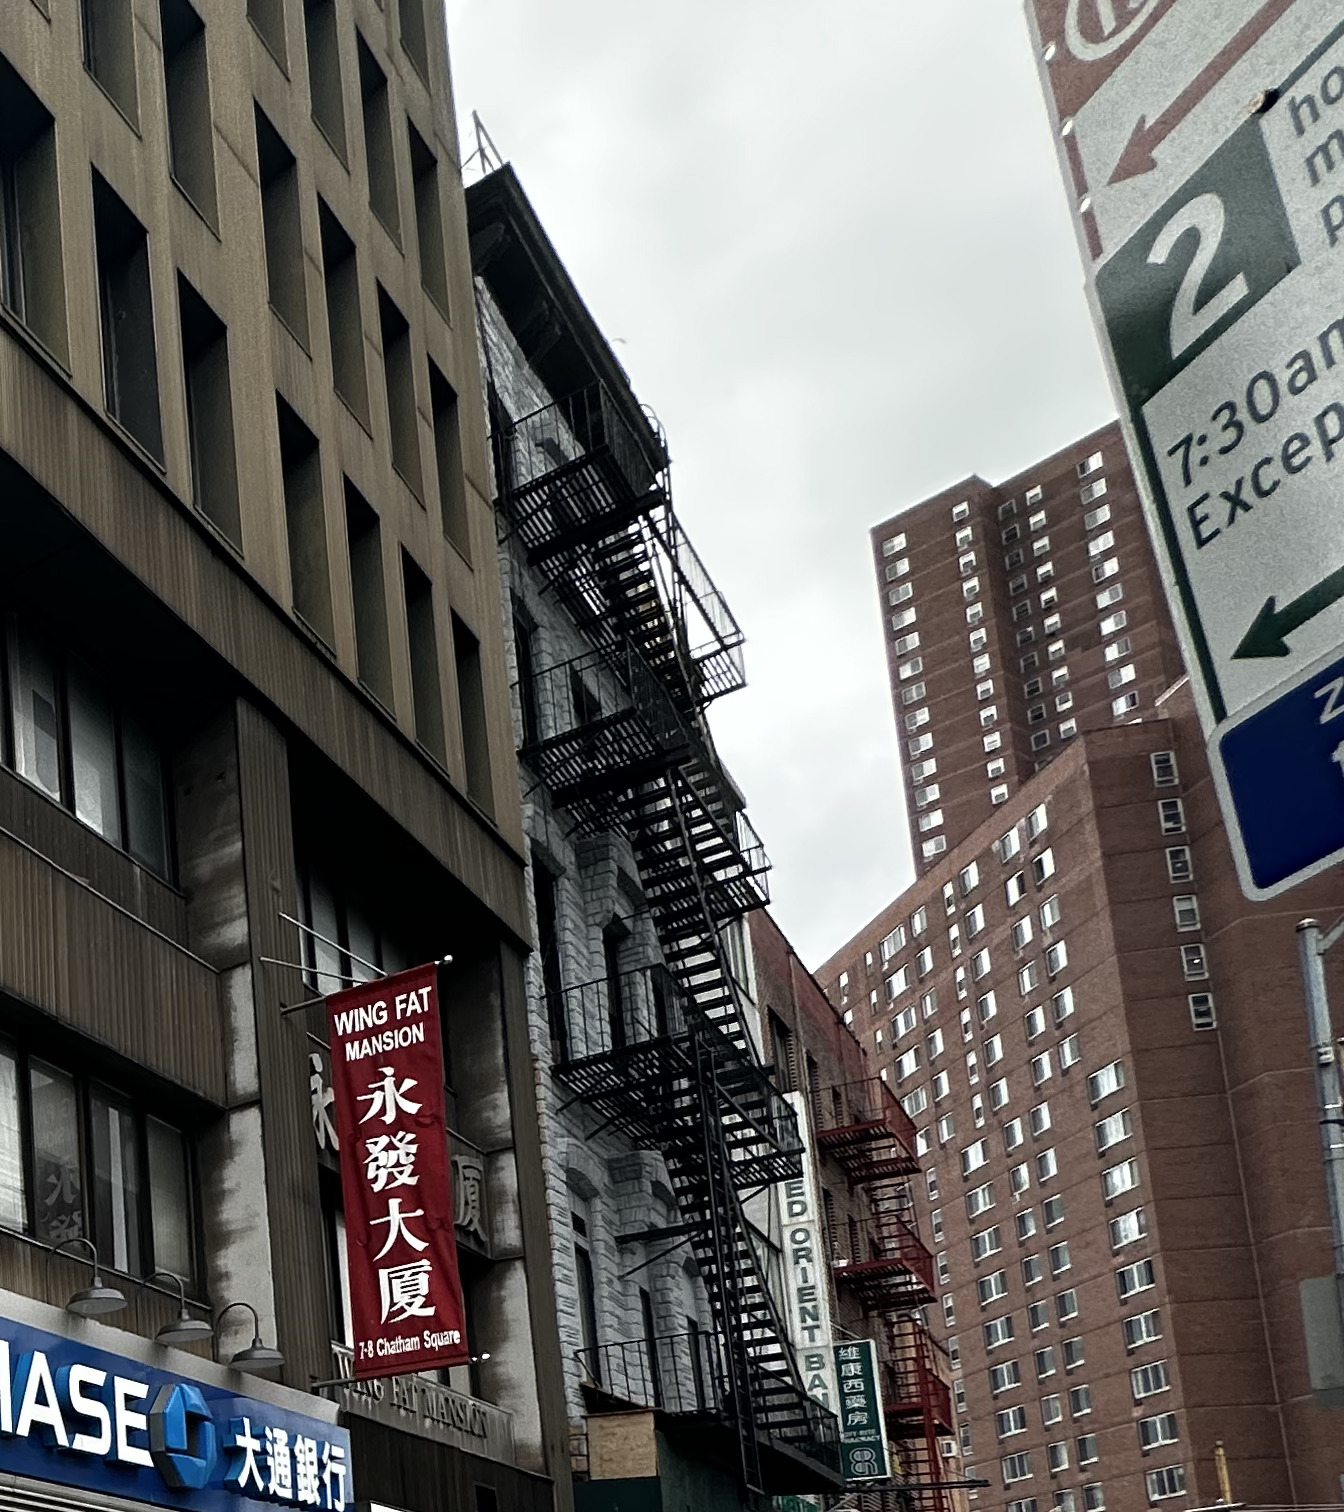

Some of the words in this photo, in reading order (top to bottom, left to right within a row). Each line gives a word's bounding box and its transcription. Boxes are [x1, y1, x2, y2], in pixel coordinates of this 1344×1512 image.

[1146, 191, 1250, 361] 2
[334, 1000, 388, 1036] WING
[395, 986, 432, 1020] FAT
[345, 1022, 425, 1061] MANSION
[356, 1066, 436, 1325] 永發大廈
[790, 1227, 821, 1343] ORIENT
[359, 1339, 374, 1360] 7-8
[376, 1335, 421, 1357] Chatham
[423, 1330, 461, 1351] Square
[232, 1416, 348, 1512] 大通銀行
